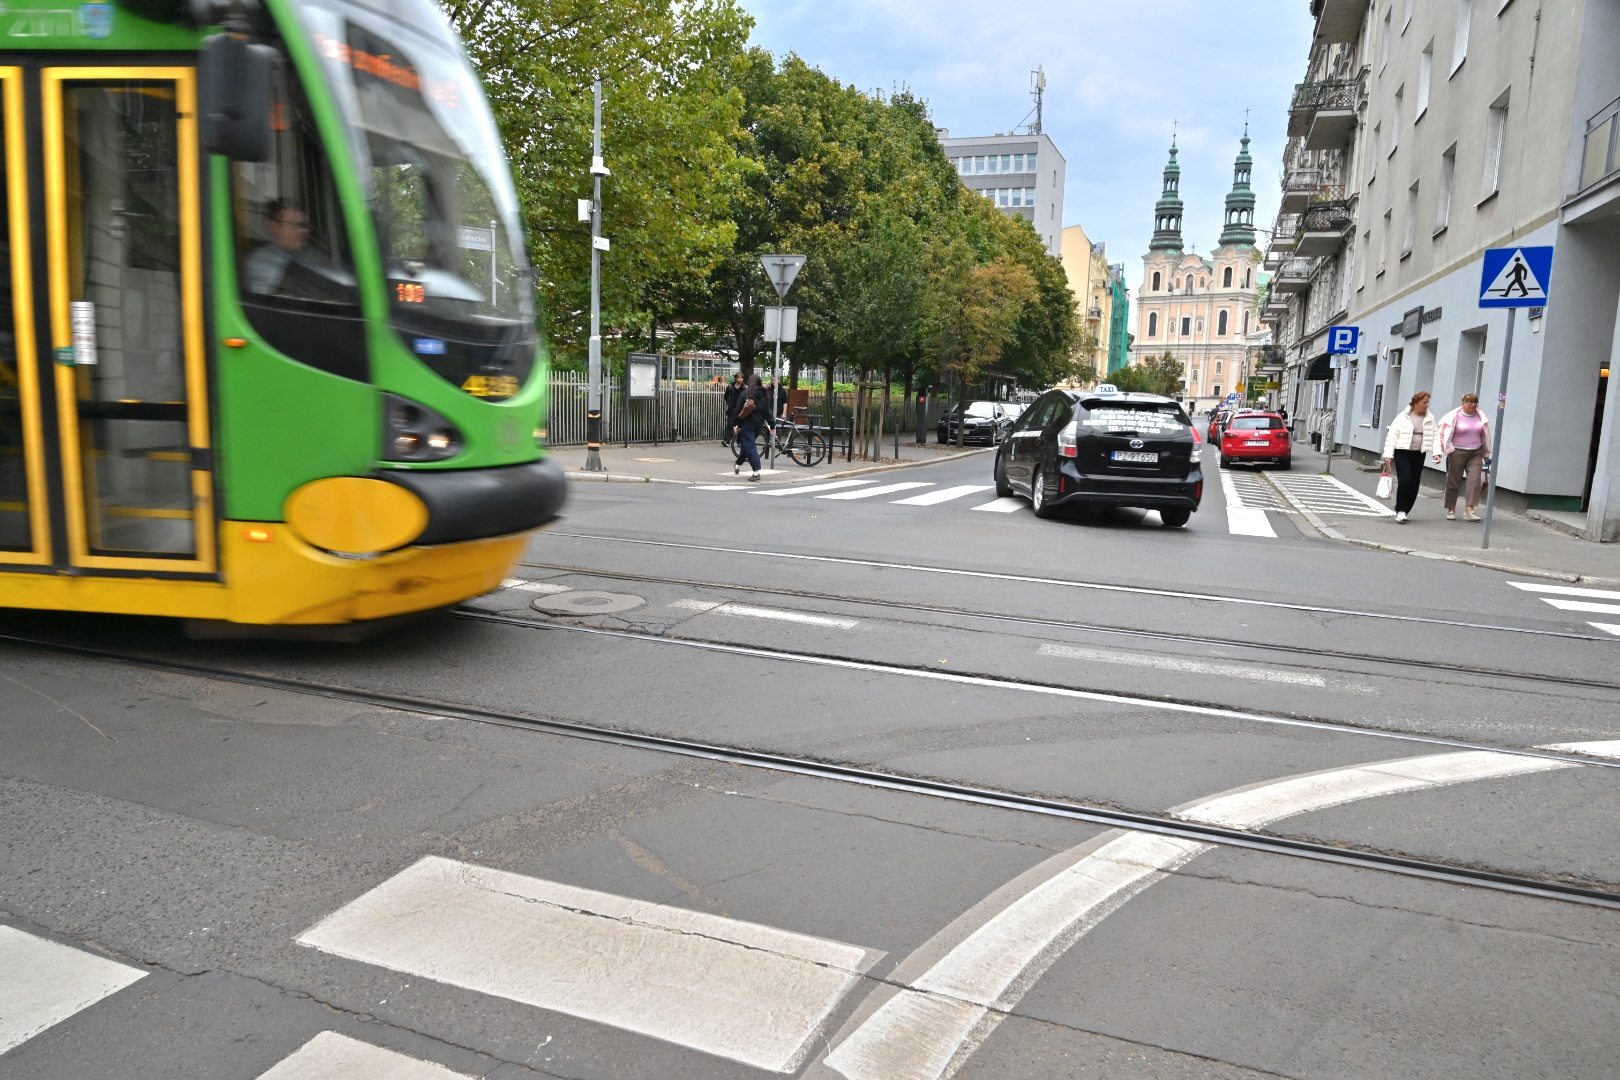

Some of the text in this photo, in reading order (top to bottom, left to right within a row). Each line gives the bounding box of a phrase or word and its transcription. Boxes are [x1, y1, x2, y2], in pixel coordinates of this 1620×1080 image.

[1334, 329, 1353, 351] P
[1116, 451, 1156, 462] PZ 9T650
